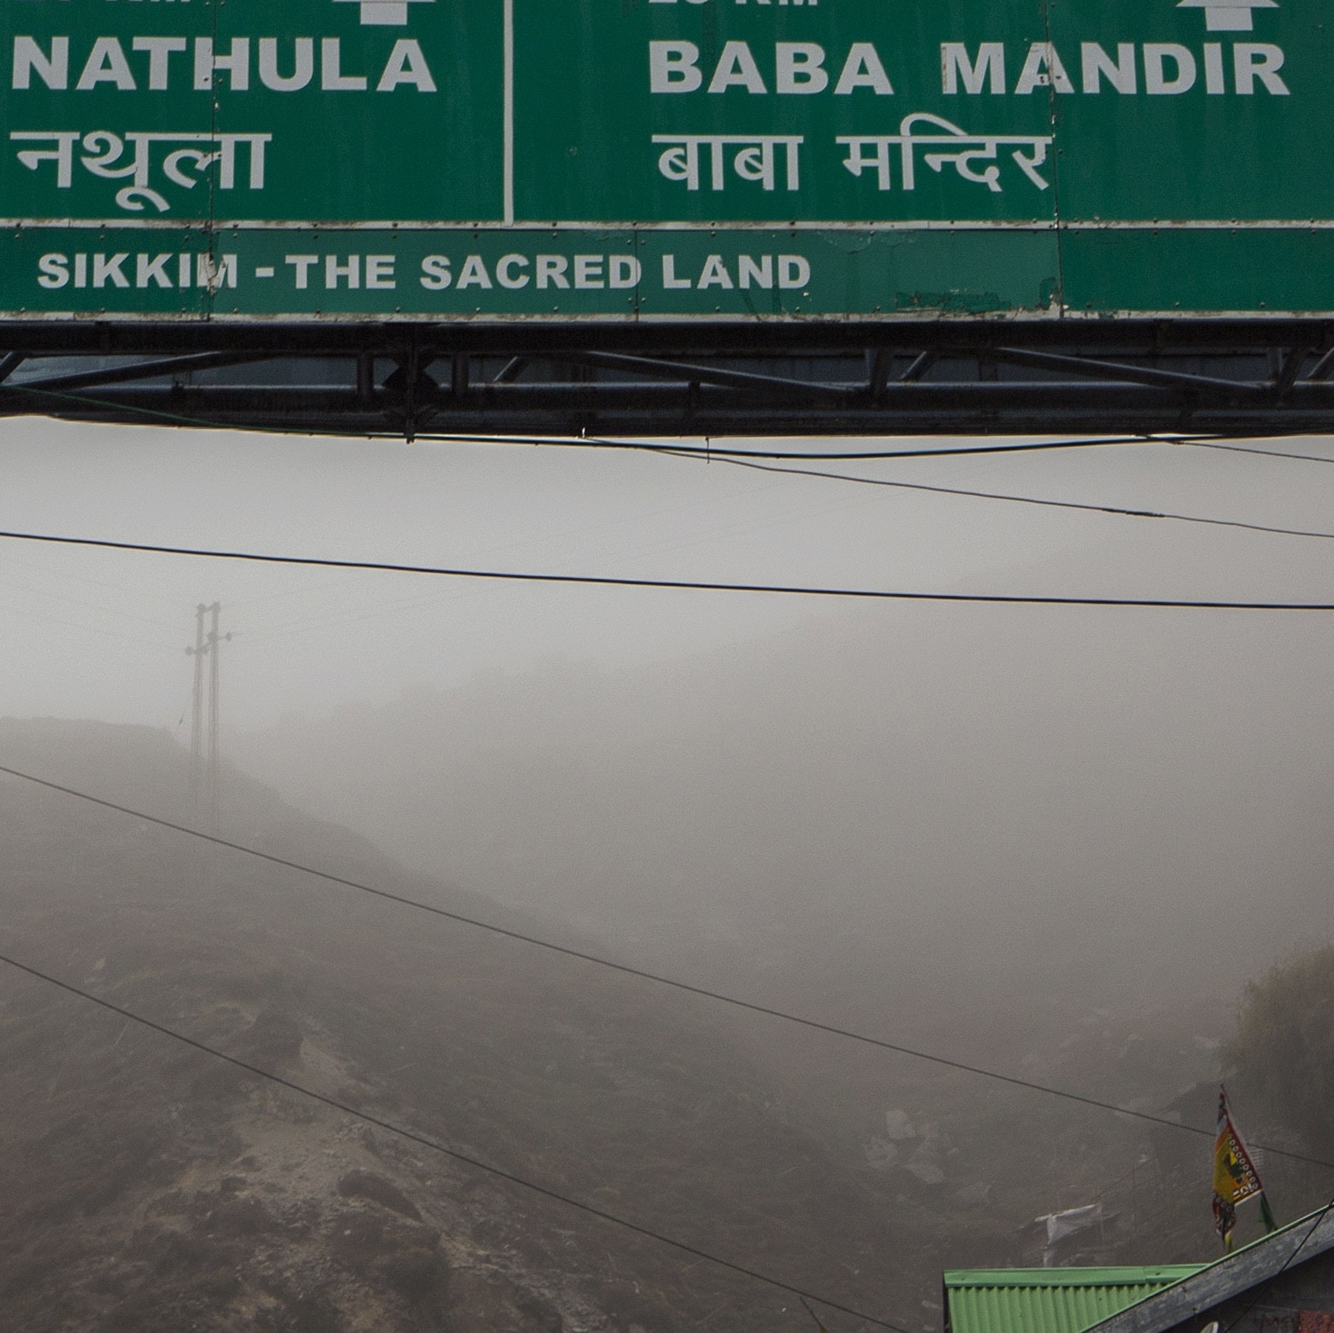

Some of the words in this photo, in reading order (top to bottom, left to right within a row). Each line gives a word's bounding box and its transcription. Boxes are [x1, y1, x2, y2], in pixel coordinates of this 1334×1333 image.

[12, 35, 437, 92] NATHULA
[649, 40, 894, 95] BABA
[940, 41, 1291, 96] MANDIR
[9, 130, 273, 212] नथूला
[651, 134, 804, 191] बाबा
[835, 112, 1053, 192] मन्दिर
[37, 252, 238, 291] SIKKIM
[284, 254, 396, 289] THE
[419, 253, 642, 290] SACRED
[661, 254, 811, 290] LAND
